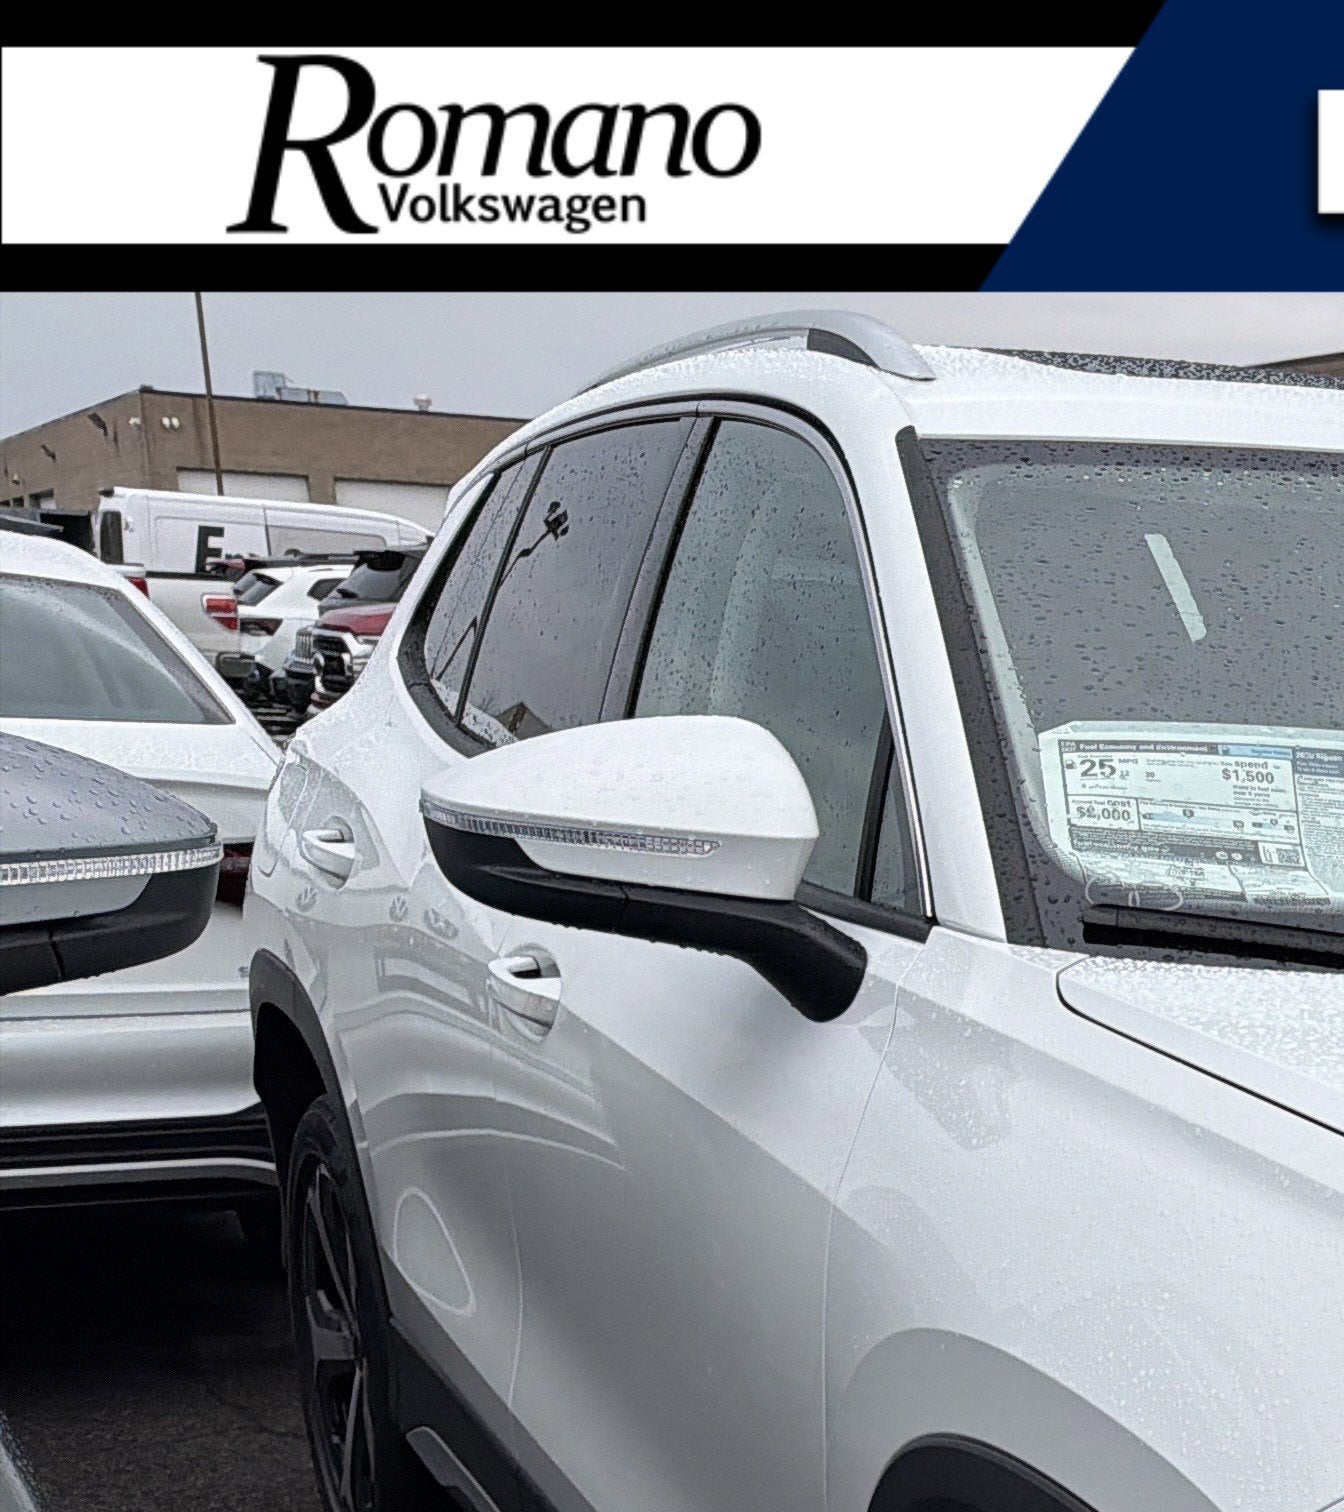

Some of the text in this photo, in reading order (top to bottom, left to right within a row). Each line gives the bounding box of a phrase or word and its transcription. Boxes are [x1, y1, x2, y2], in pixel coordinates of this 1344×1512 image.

[1079, 758, 1117, 778] 25
[1234, 761, 1269, 770] spend
[1221, 768, 1275, 784] $1,500
